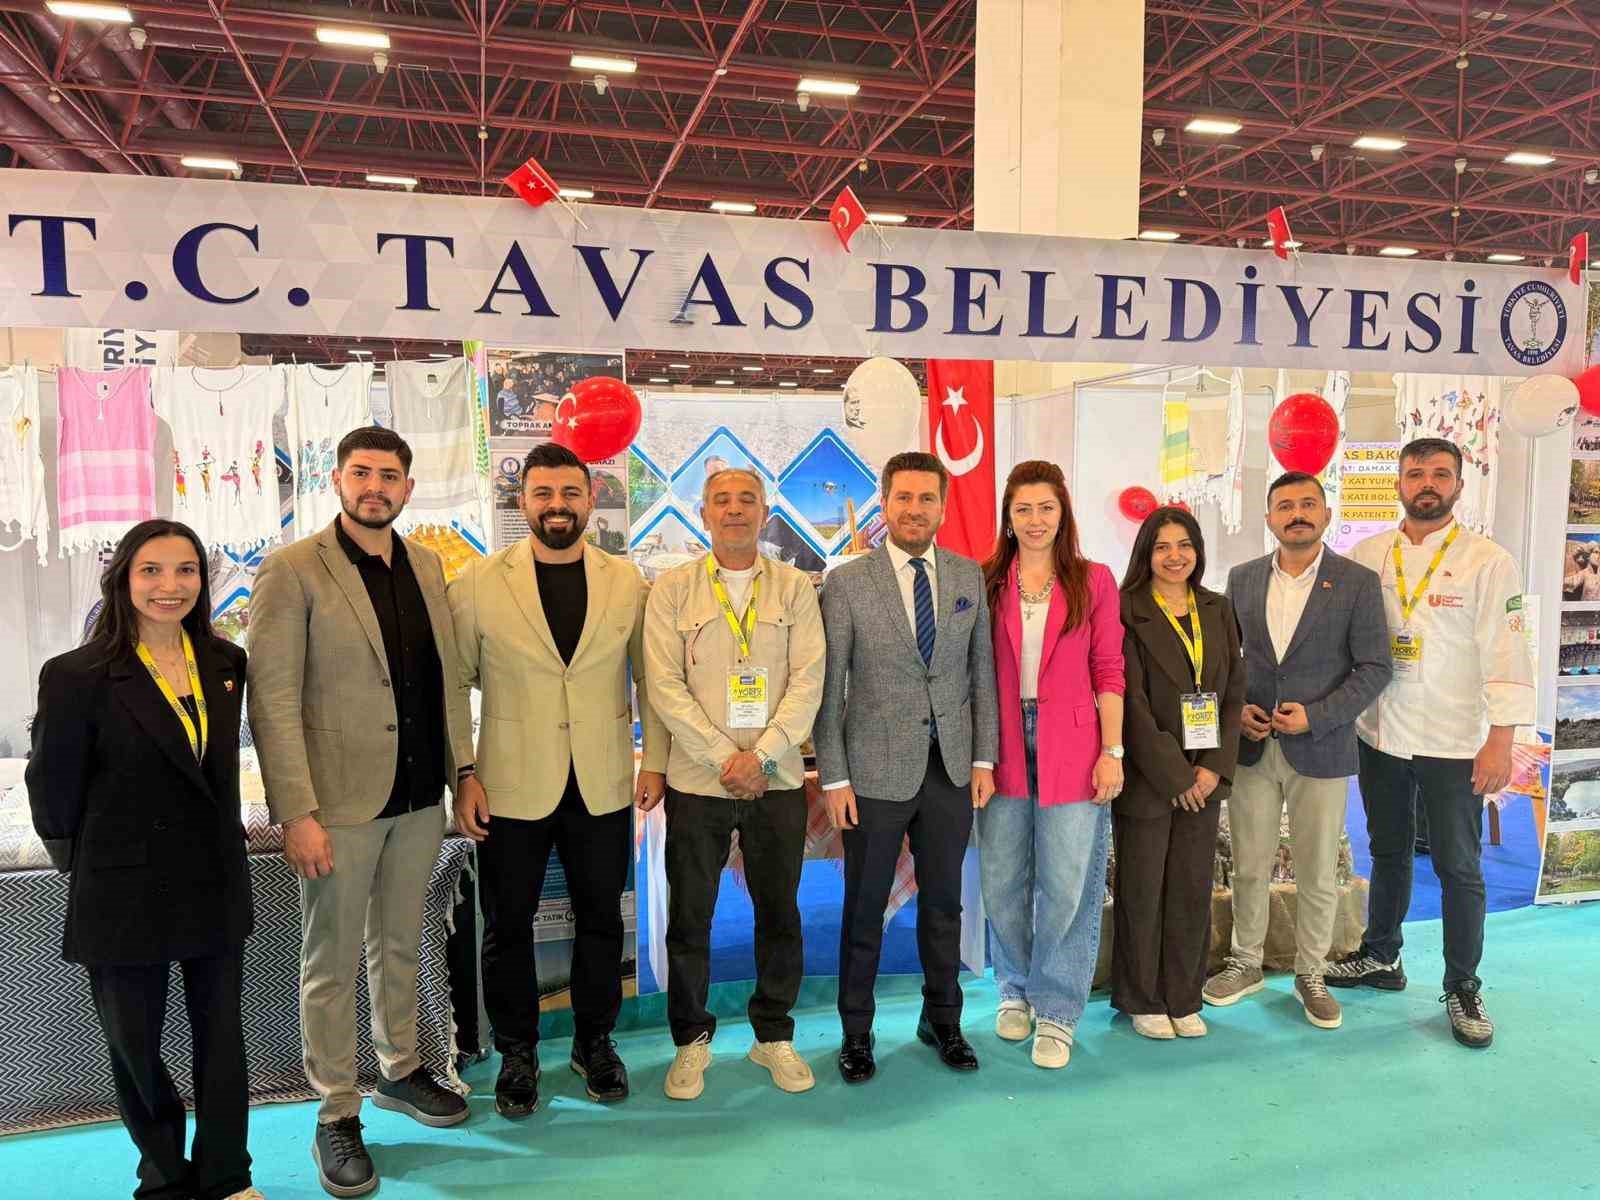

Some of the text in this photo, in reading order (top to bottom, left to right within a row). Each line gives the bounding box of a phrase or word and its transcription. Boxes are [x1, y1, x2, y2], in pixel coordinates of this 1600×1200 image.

[8, 213, 1483, 355] T.C. TAVAS BELEDİYESİ
[506, 421, 541, 429] TOPRAK
[1358, 464, 1392, 472] DAMAK
[1368, 477, 1394, 485] YUFK
